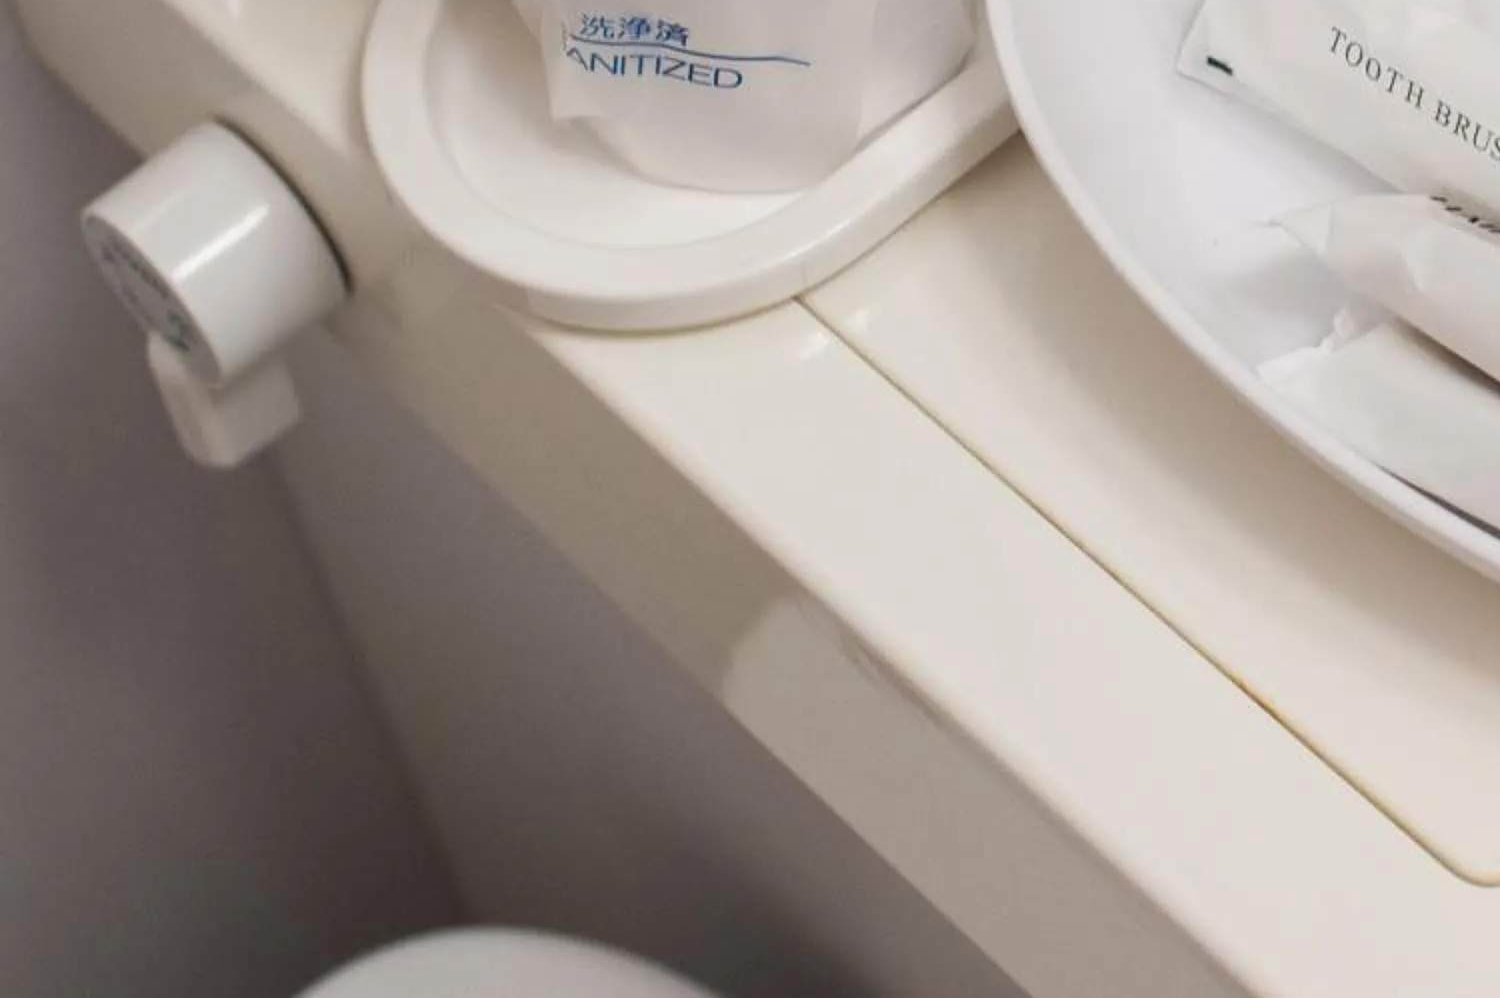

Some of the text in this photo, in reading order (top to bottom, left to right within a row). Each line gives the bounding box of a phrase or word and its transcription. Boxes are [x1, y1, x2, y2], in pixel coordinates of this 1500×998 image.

[579, 14, 688, 47] 洗浄済
[563, 47, 743, 89] ANITIZED
[1329, 25, 1425, 110] TOOTH
